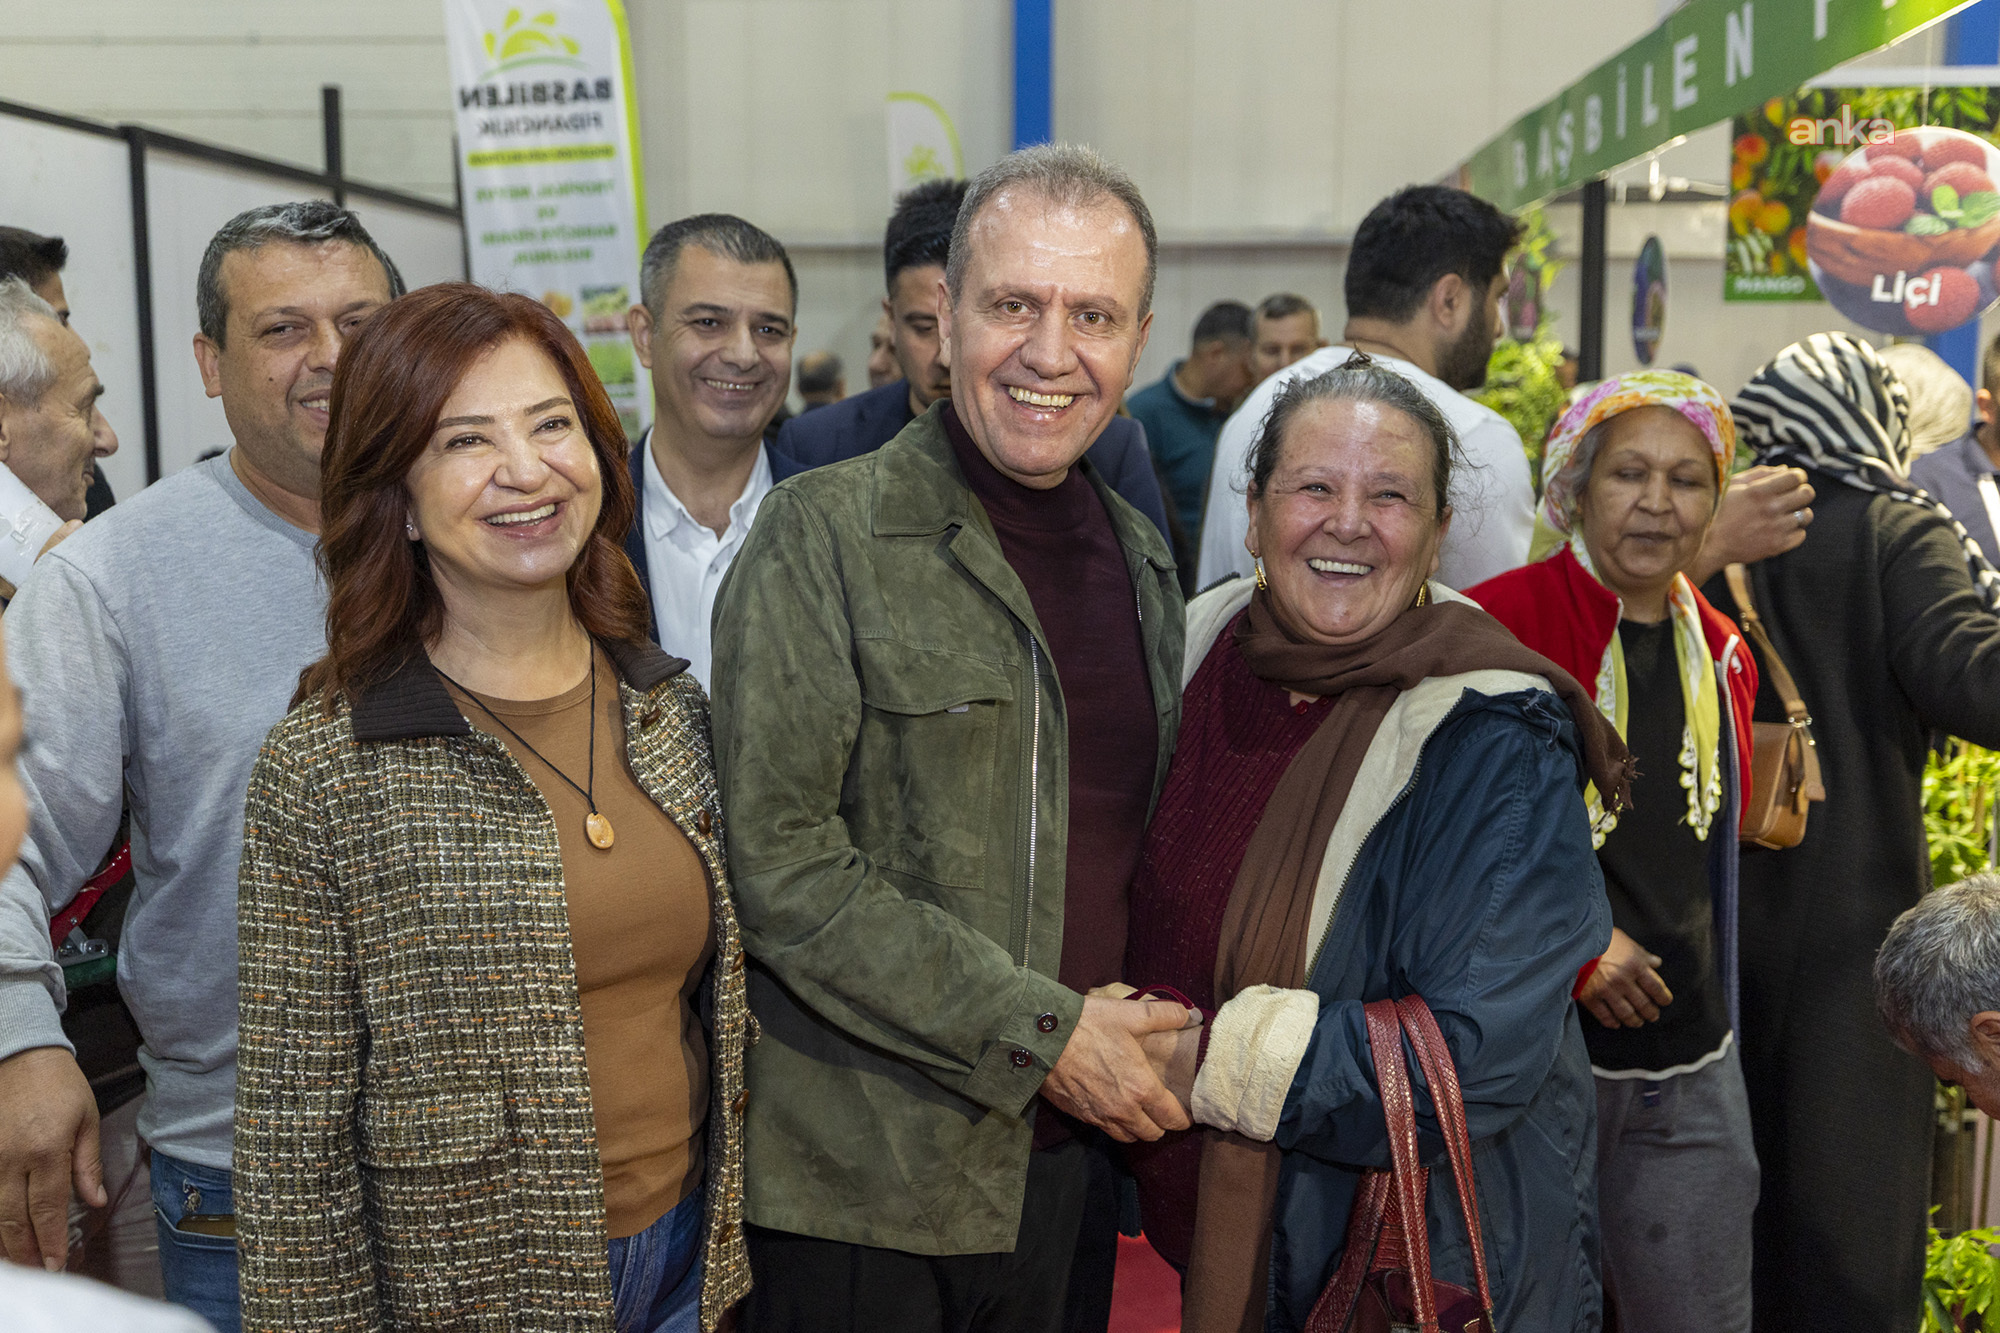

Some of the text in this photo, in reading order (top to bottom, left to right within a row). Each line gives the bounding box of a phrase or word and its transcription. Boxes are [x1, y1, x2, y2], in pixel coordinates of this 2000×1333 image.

[1513, 2, 1754, 190] BAŞBİLEN
[1734, 275, 1806, 295] MANGO
[1871, 271, 1943, 309] LİÇİ
